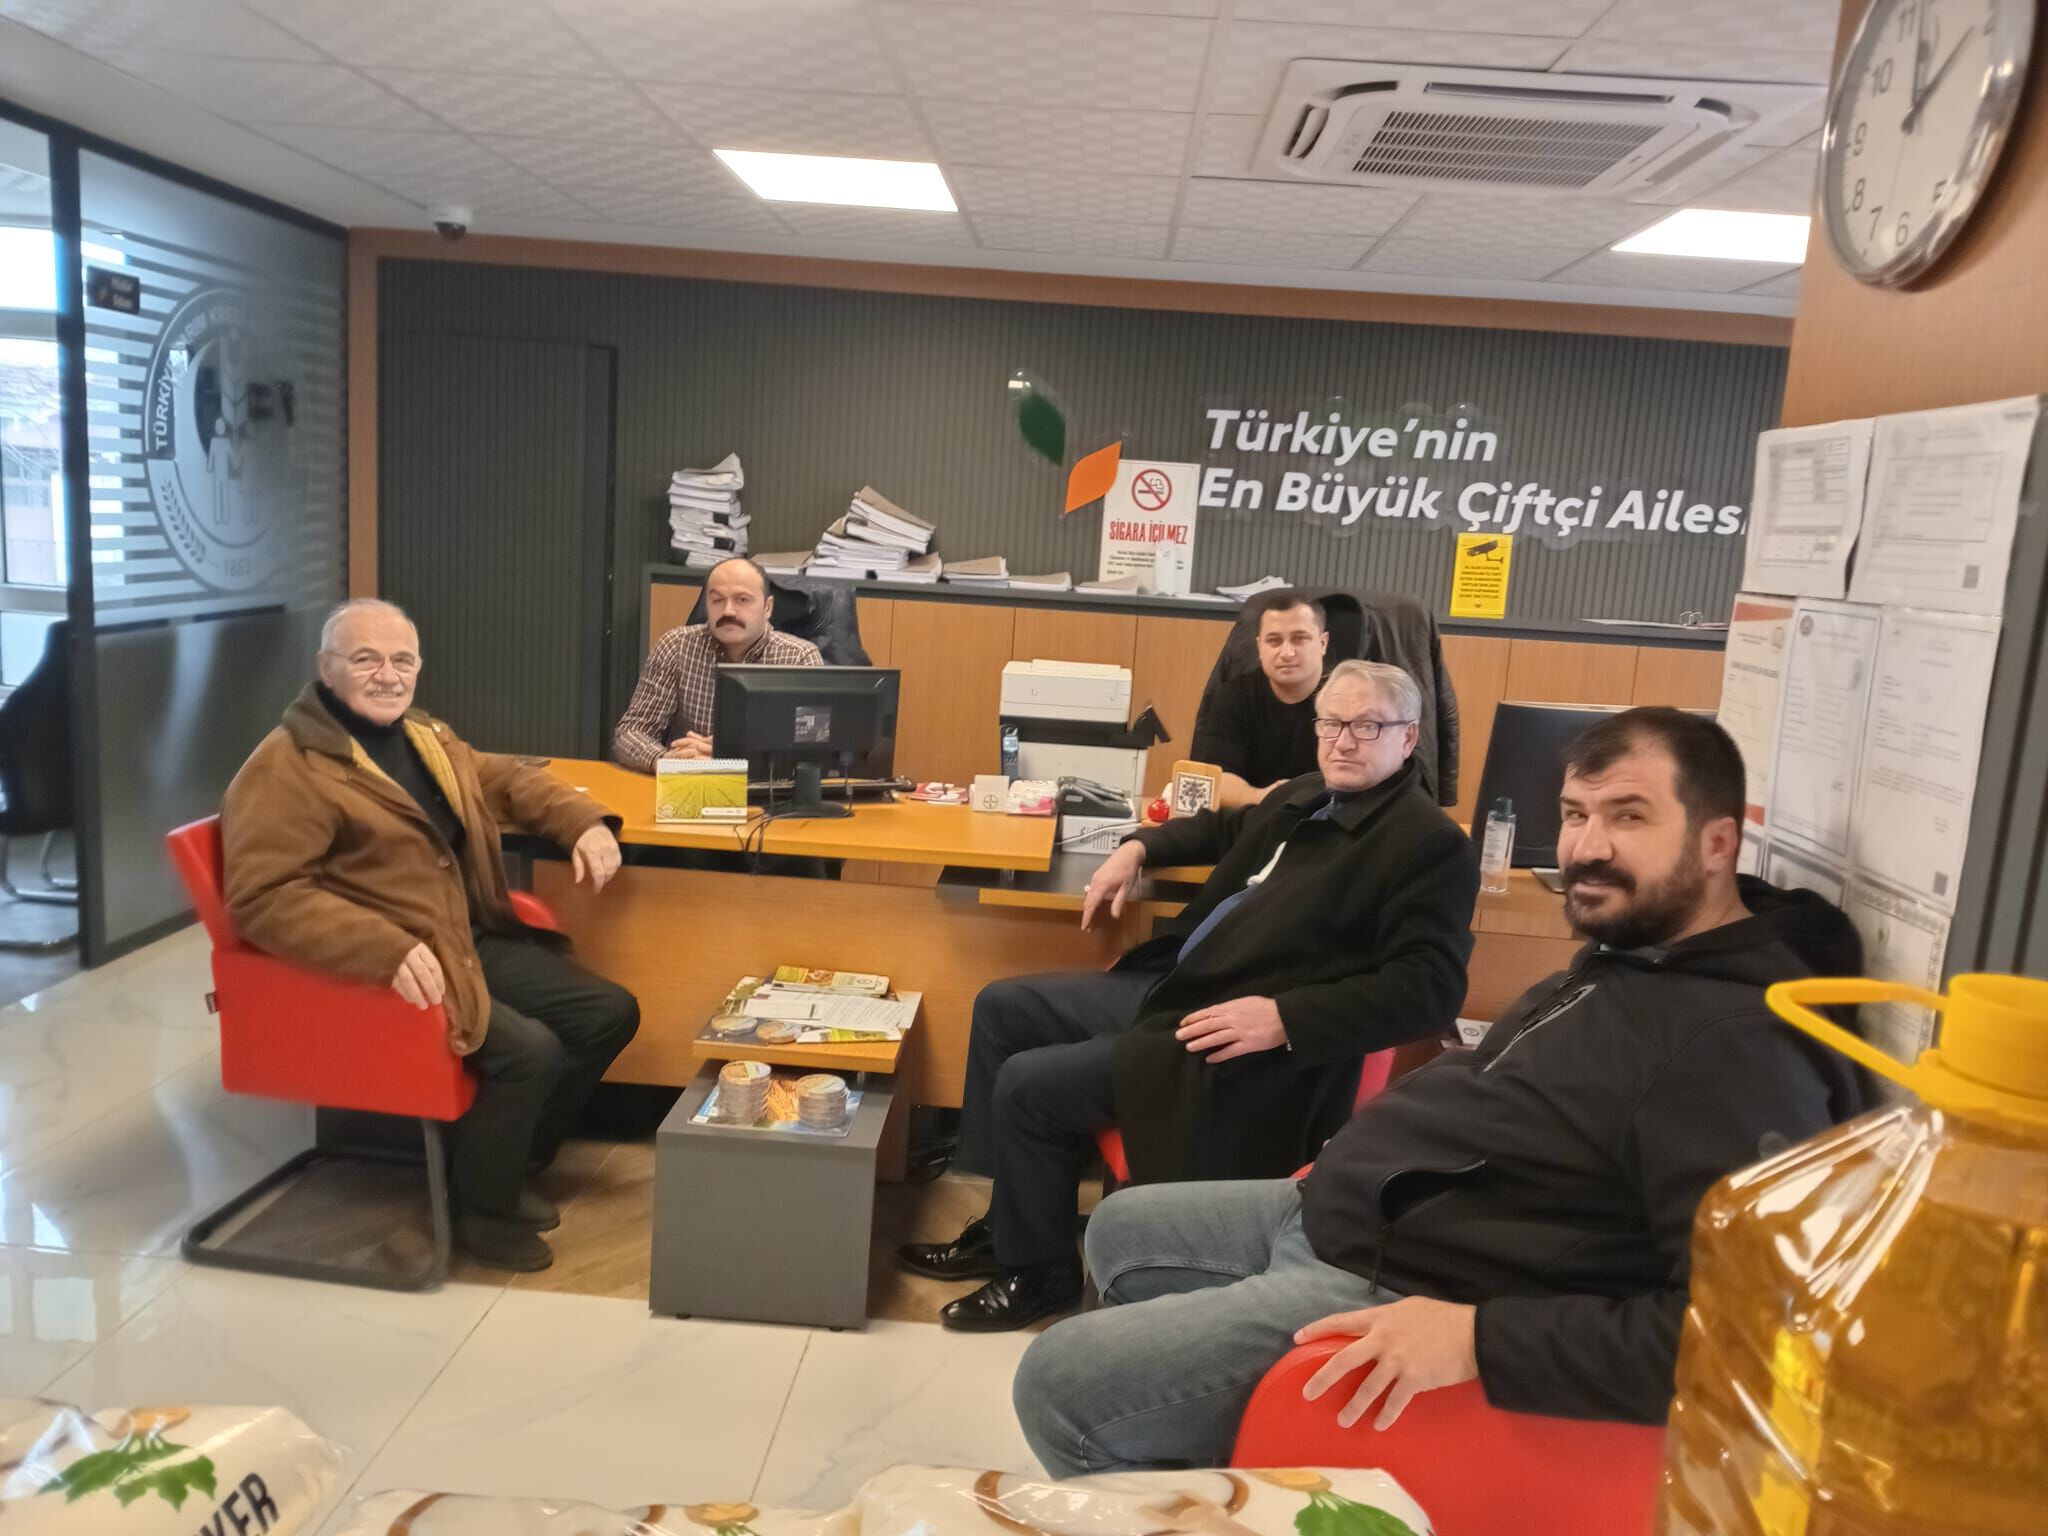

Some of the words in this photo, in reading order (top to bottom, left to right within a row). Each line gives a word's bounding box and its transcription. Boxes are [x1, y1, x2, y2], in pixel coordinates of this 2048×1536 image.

[1871, 57, 1893, 97] 10
[1852, 121, 1867, 156] 9
[1853, 178, 1866, 212] 8
[1870, 206, 1883, 241] 7
[1896, 212, 1910, 247] 6
[1206, 409, 1498, 466] Türkiye'nin
[1199, 467, 1264, 509] En
[1275, 471, 1443, 526] Büyük
[1457, 481, 1602, 536] Çiftçi
[1605, 489, 1746, 535] Ailes
[1109, 518, 1146, 542] SİGARA
